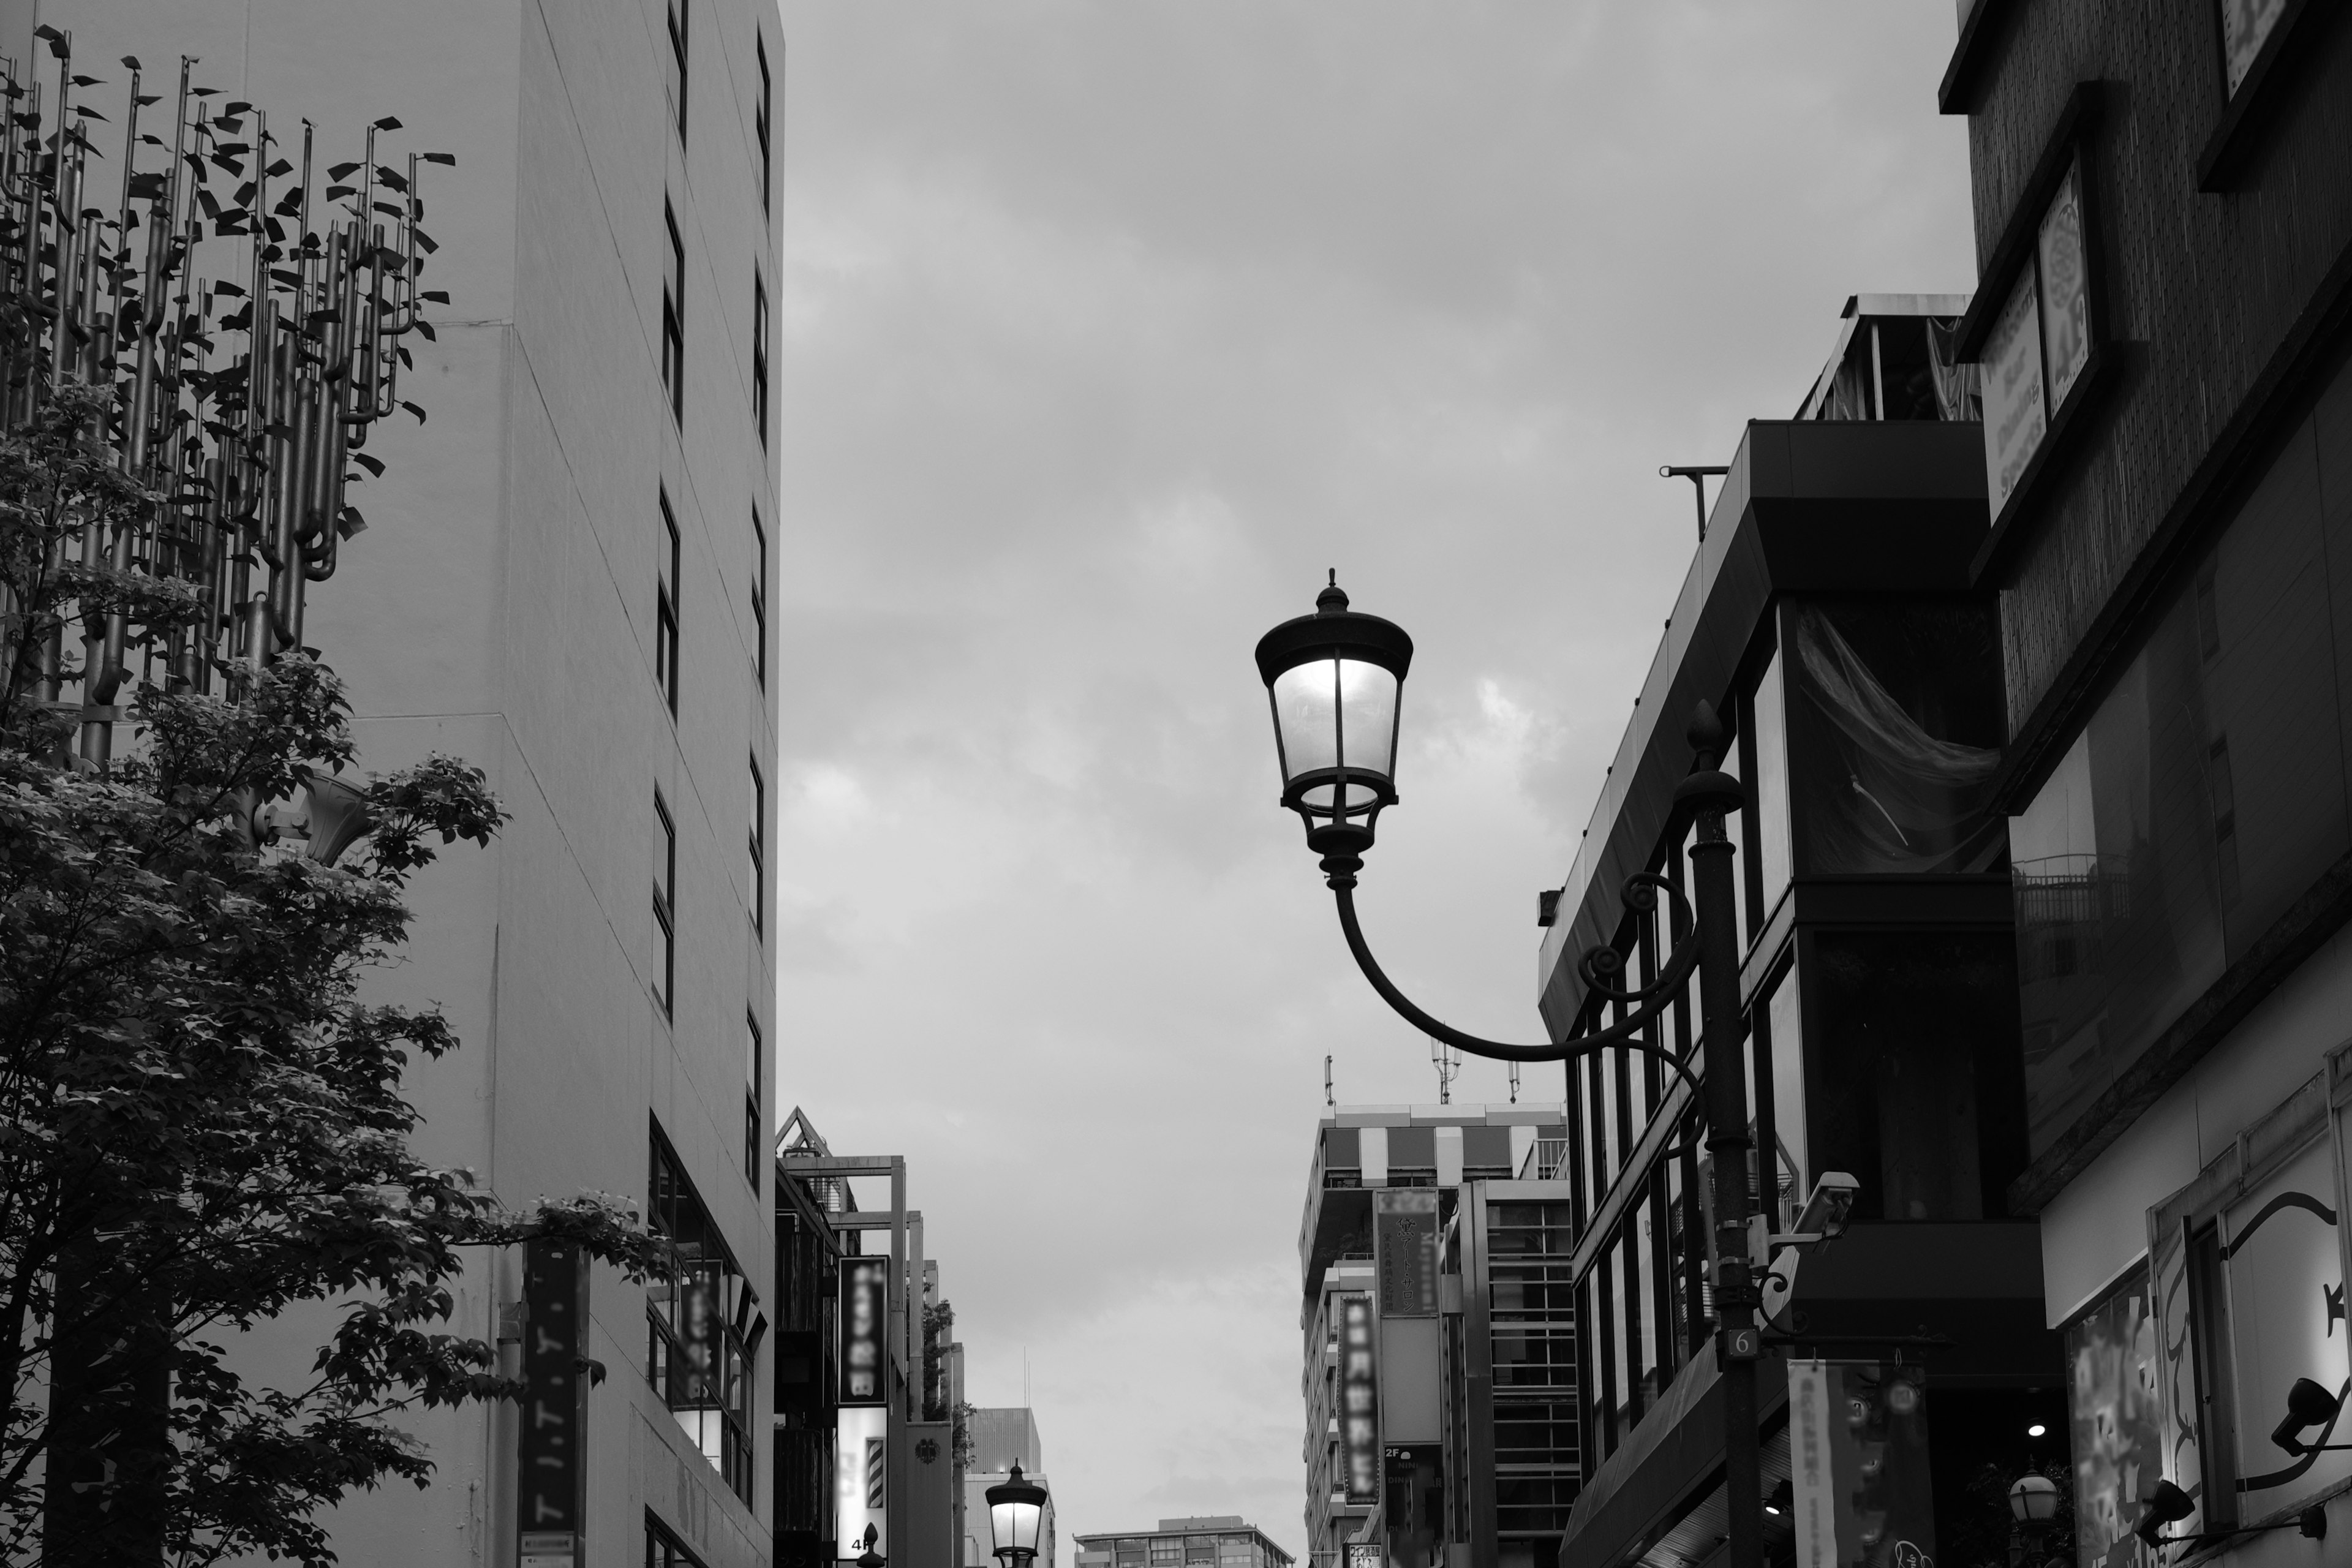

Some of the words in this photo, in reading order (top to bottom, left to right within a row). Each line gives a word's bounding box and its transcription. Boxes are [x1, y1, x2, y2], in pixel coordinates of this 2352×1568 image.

[1735, 1331, 1749, 1353] 6
[1385, 1448, 1400, 1458] 2F
[1351, 1546, 1380, 1557] ワイン居酒屋
